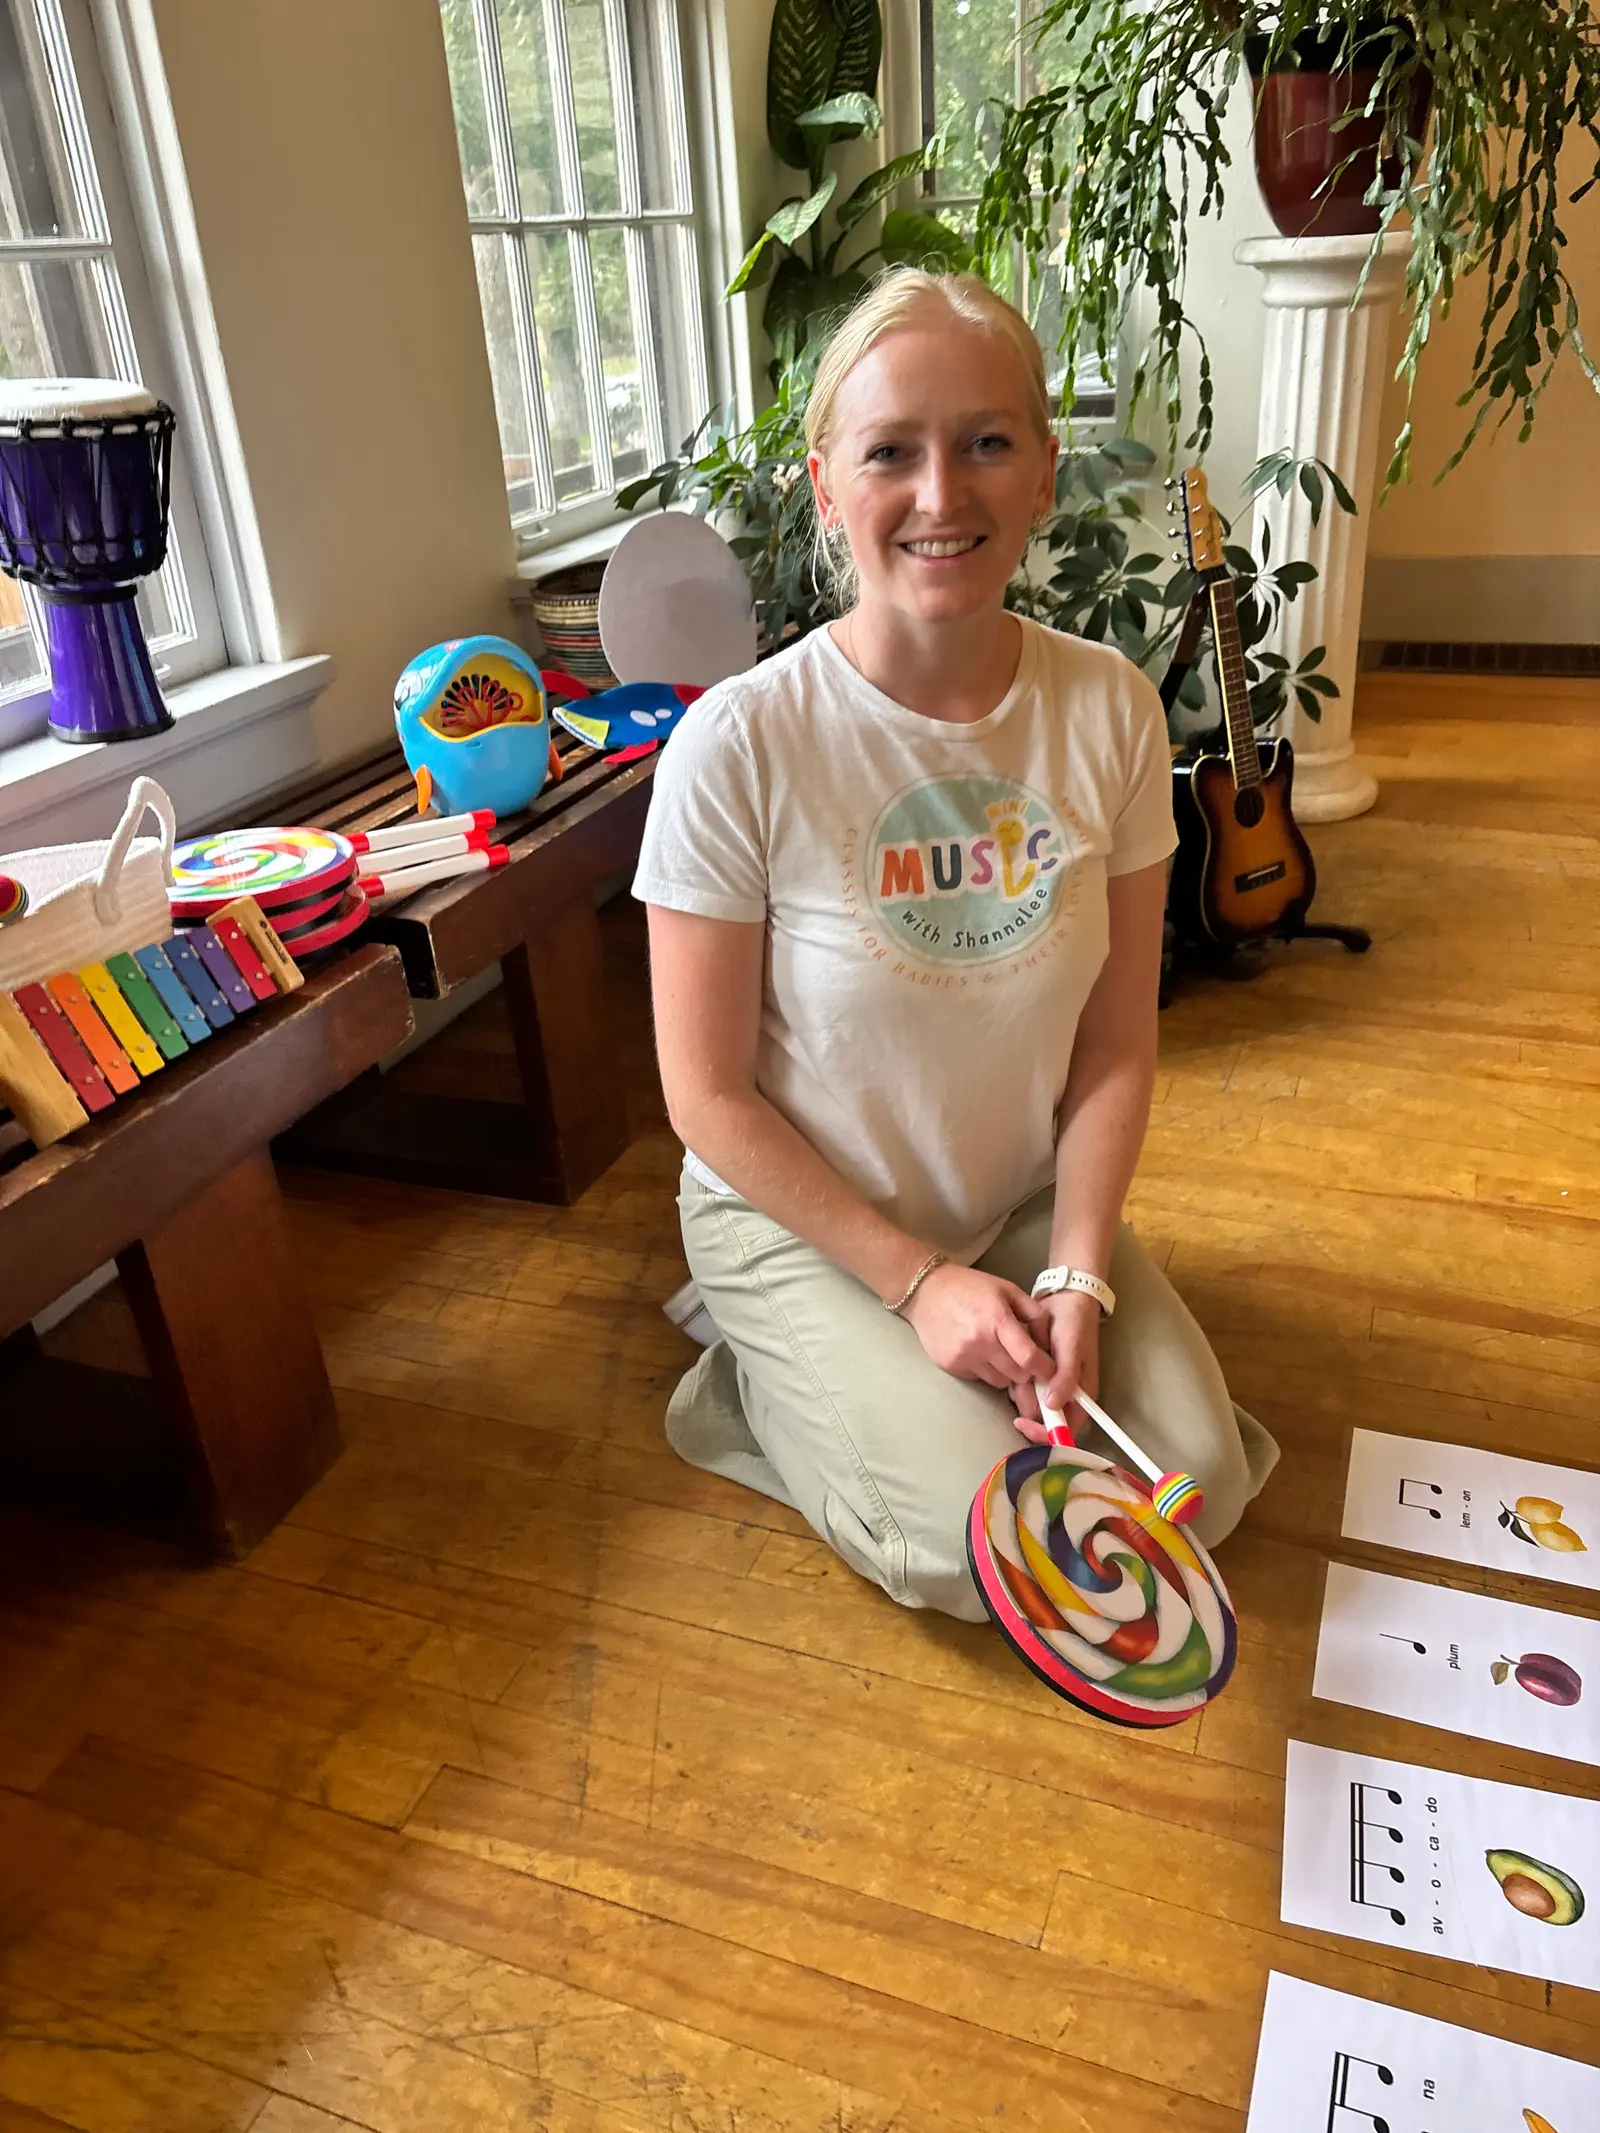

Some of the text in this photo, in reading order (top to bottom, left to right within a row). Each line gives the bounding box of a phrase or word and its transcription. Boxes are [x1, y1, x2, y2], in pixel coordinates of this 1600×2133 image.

[985, 798, 1029, 818] MINI
[880, 819, 1058, 897] MUSIC
[841, 828, 858, 918] CLASSES
[856, 925, 887, 962] FOR
[892, 962, 968, 988] BABIES
[982, 972, 995, 984] &
[1010, 928, 1068, 976] THEIR
[901, 888, 1048, 948] with Shannalee
[1462, 1490, 1472, 1502] on
[1459, 1512, 1471, 1529] lem
[1446, 1643, 1462, 1671] plum
[1424, 1796, 1438, 1814] do
[1428, 1835, 1440, 1852] ca
[1430, 1879, 1442, 1889] o
[1432, 1916, 1445, 1935] av
[1422, 2078, 1436, 2101] na
